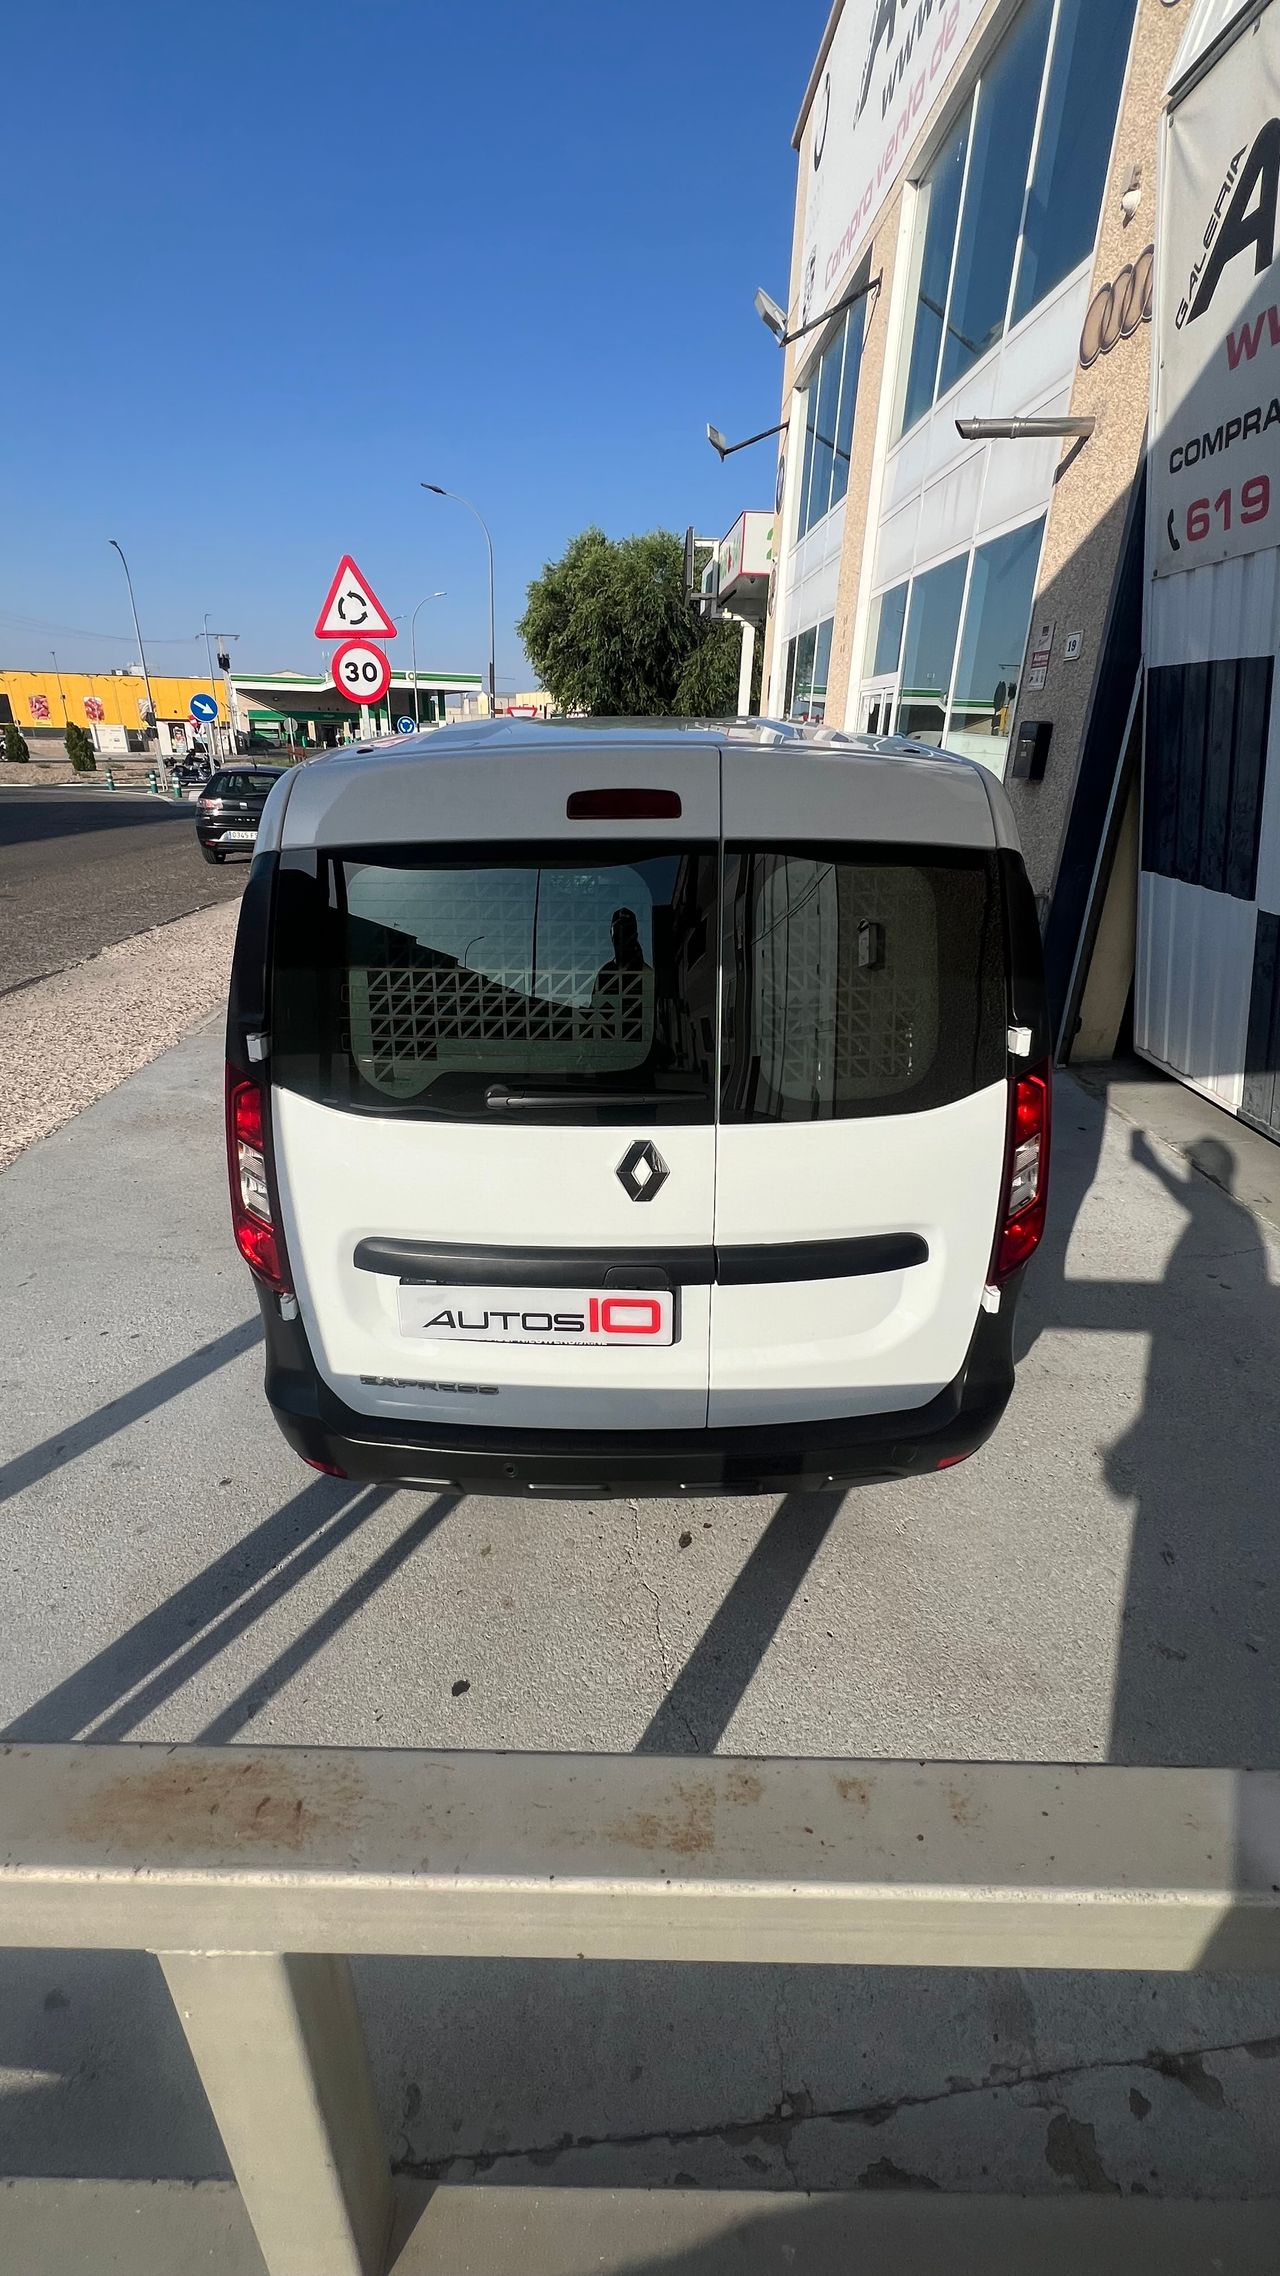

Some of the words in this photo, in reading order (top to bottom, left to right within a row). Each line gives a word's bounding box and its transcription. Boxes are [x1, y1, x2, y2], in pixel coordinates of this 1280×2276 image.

[877, 68, 926, 189] venta
[1175, 143, 1249, 330] GALERIA
[1186, 474, 1270, 542] 619
[345, 662, 377, 682] 30
[1067, 640, 1077, 652] 19
[422, 1297, 661, 1335] AUTOS10
